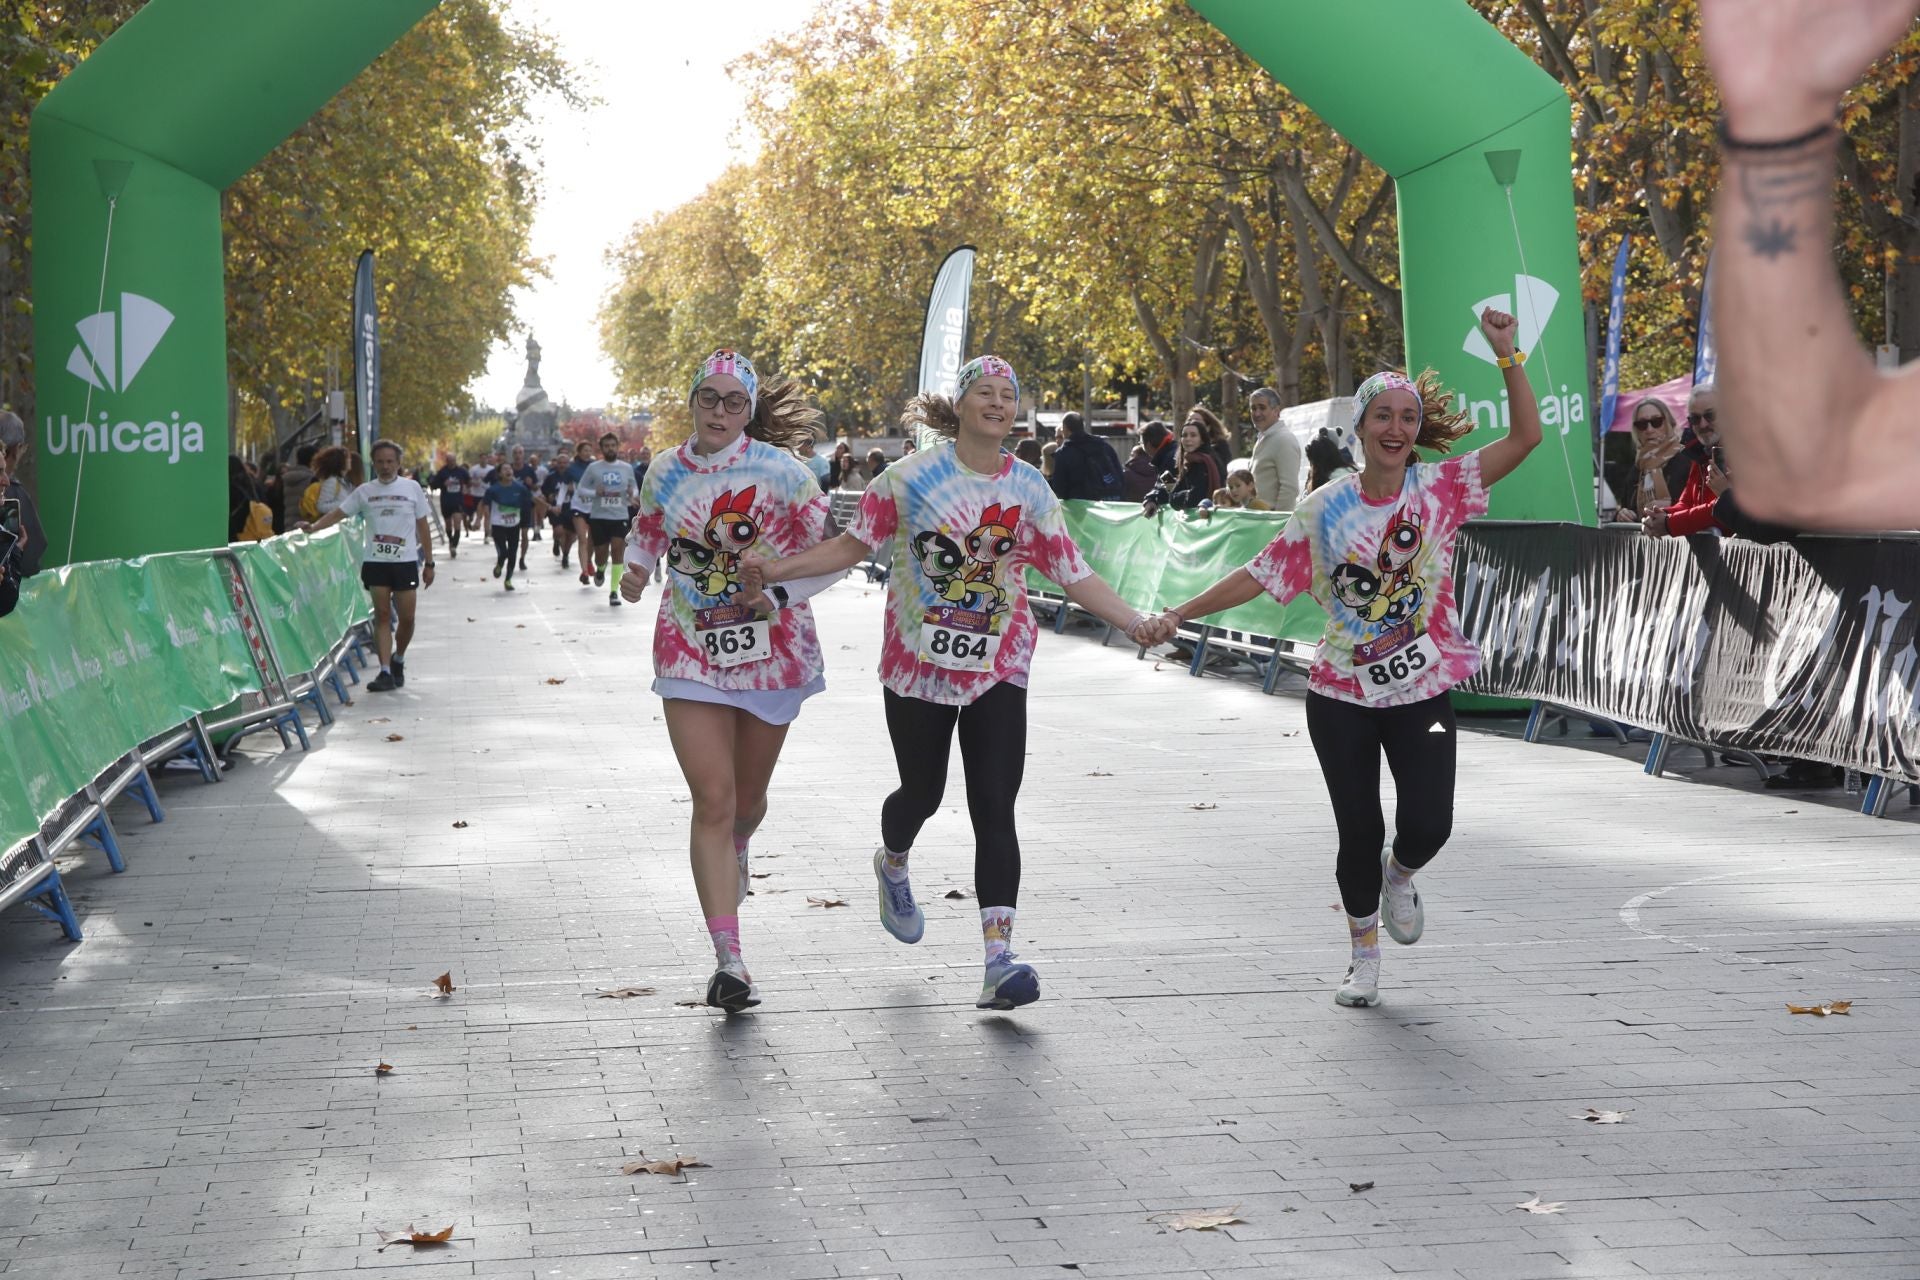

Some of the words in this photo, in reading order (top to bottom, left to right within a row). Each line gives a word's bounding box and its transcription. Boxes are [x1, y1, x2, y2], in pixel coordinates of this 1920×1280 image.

[46, 411, 204, 465] Unicaja
[376, 543, 400, 555] 387
[705, 626, 756, 657] 863
[930, 629, 988, 660] 864
[1368, 643, 1427, 686] 865
